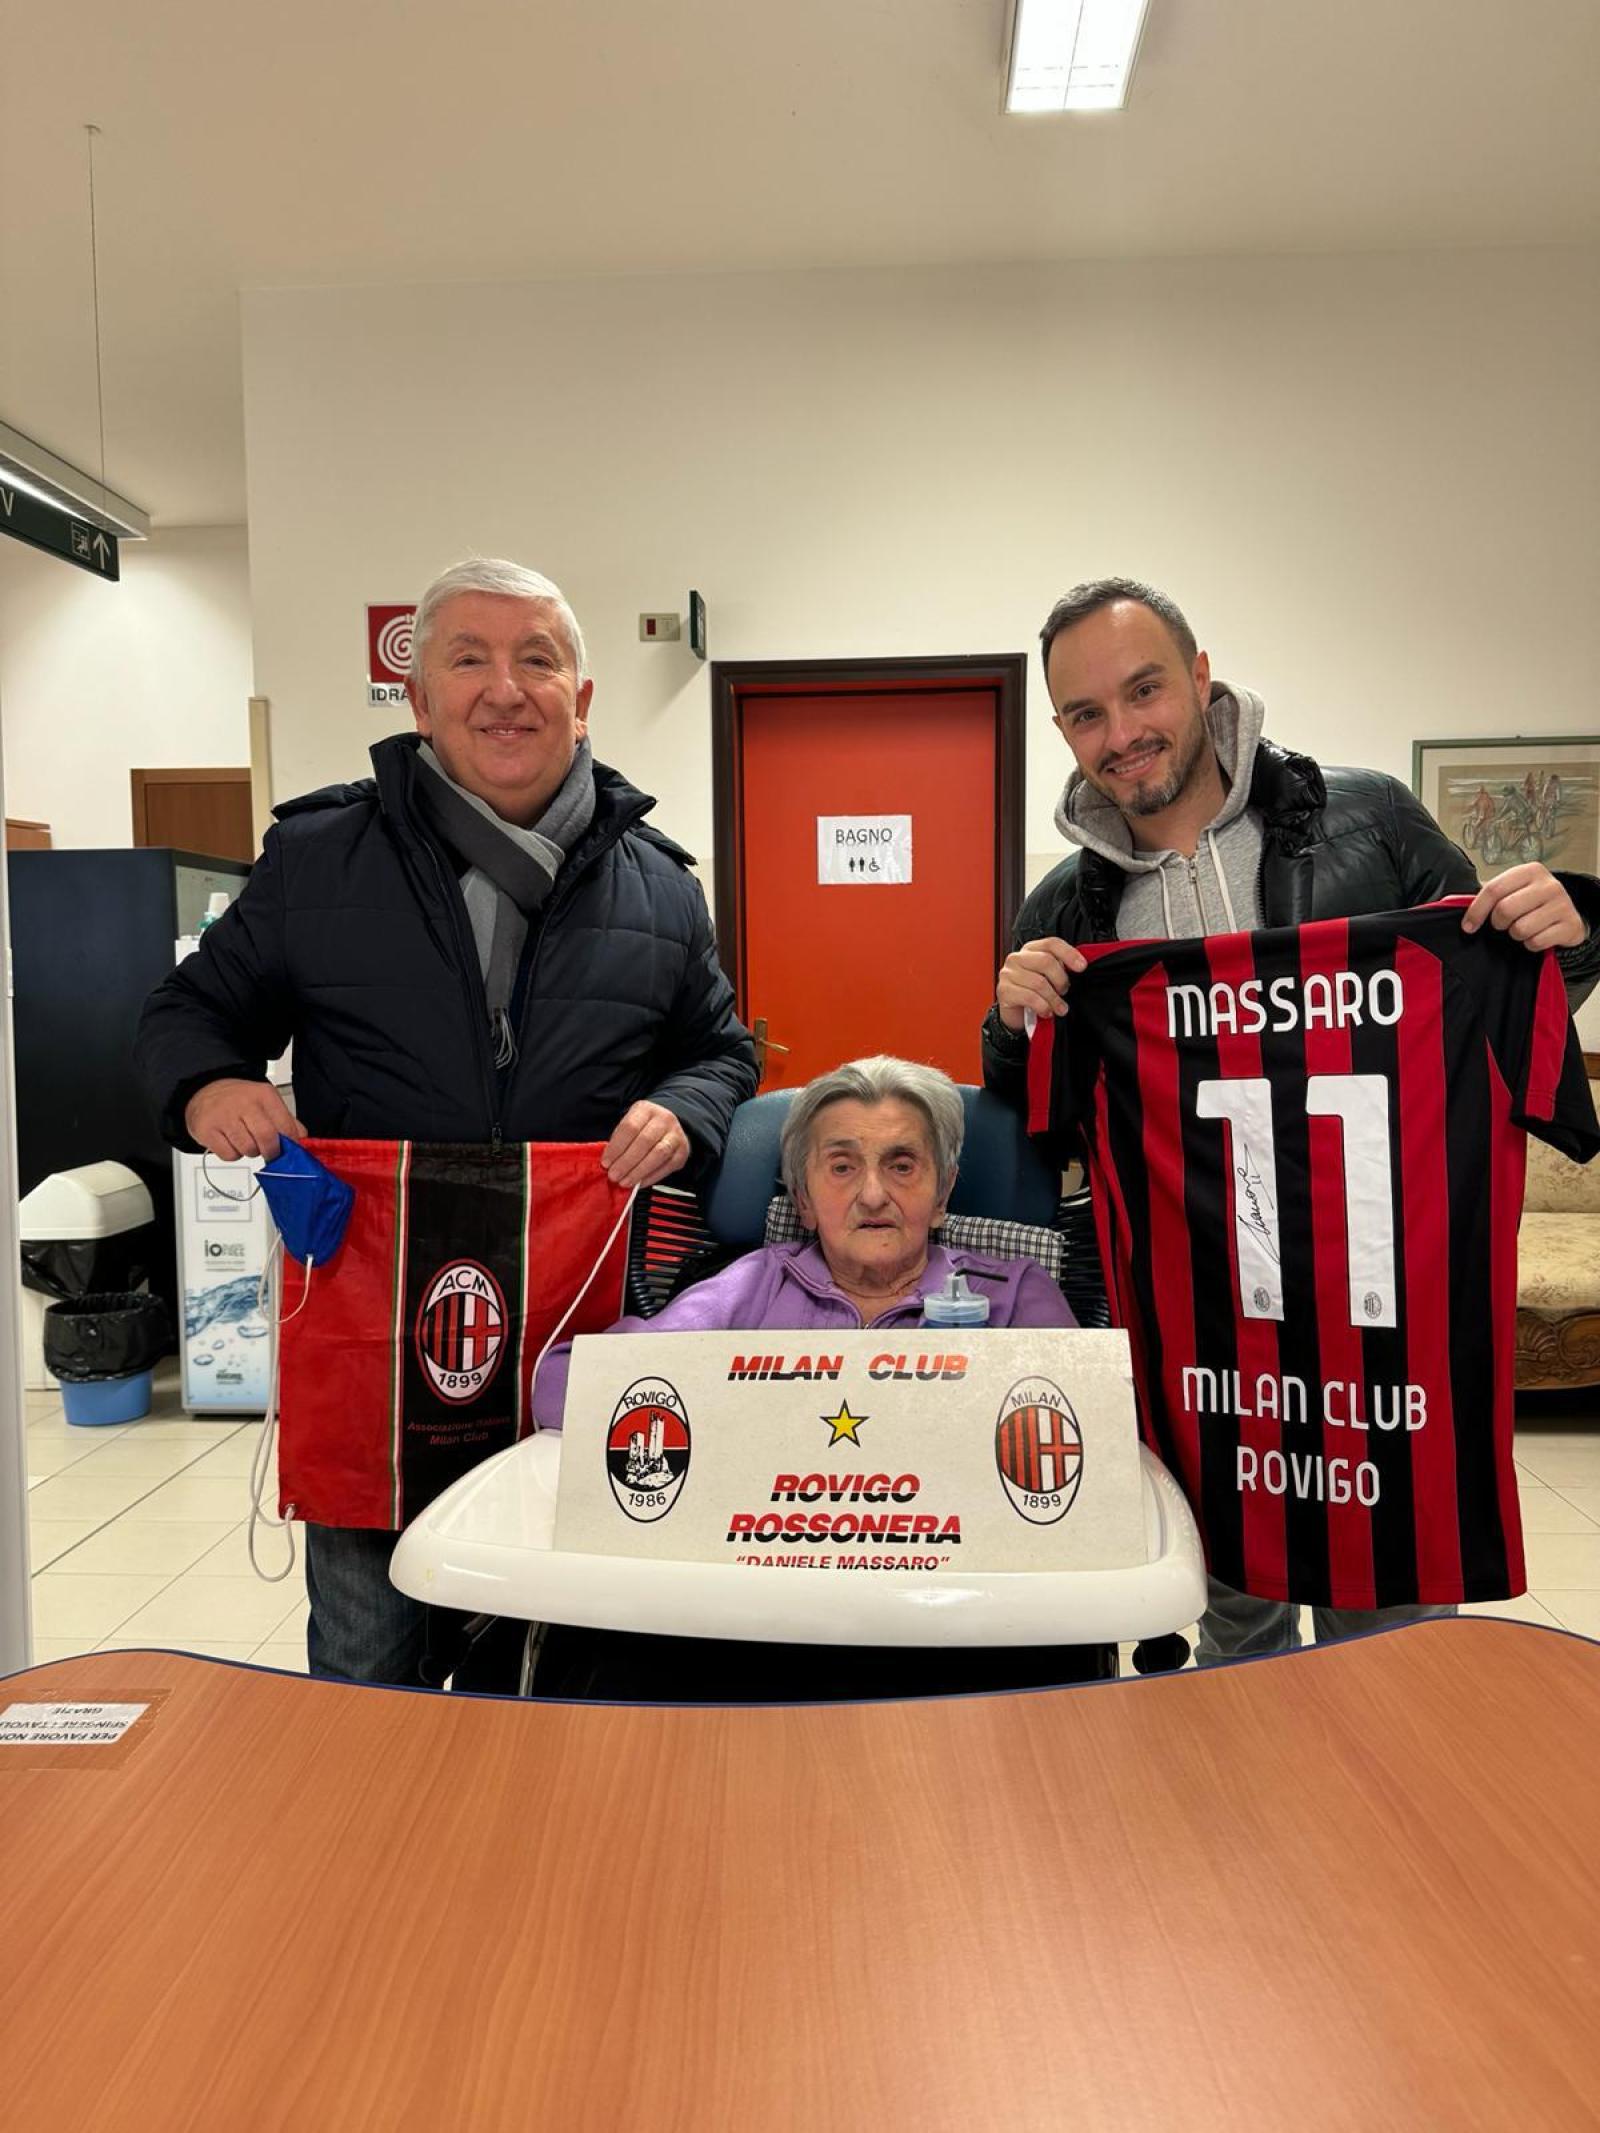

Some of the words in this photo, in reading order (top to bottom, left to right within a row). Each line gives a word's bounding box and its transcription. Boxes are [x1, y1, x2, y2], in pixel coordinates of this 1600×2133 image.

[835, 828, 893, 843] BAGNO
[1166, 969, 1404, 1038] MASSARO
[1196, 1074, 1397, 1329] 11
[438, 1269, 489, 1297] ACM
[727, 1355, 844, 1381] MILAN
[868, 1354, 969, 1381] CLUB
[438, 1372, 483, 1389] 1899
[622, 1391, 678, 1410] ROVIGO
[1011, 1391, 1061, 1408] MILAN
[1182, 1366, 1308, 1424] MILAN
[1323, 1380, 1428, 1432] CLUB
[1236, 1445, 1381, 1507] ROVIGO
[770, 1473, 921, 1502] ROVIGO
[628, 1491, 667, 1508] 1986
[1023, 1493, 1062, 1509] 1899
[726, 1513, 962, 1544] ROSSONERA
[51, 1707, 103, 1715] GRAZIE
[31, 1732, 87, 1741] FAVORE
[90, 1732, 118, 1740] PER
